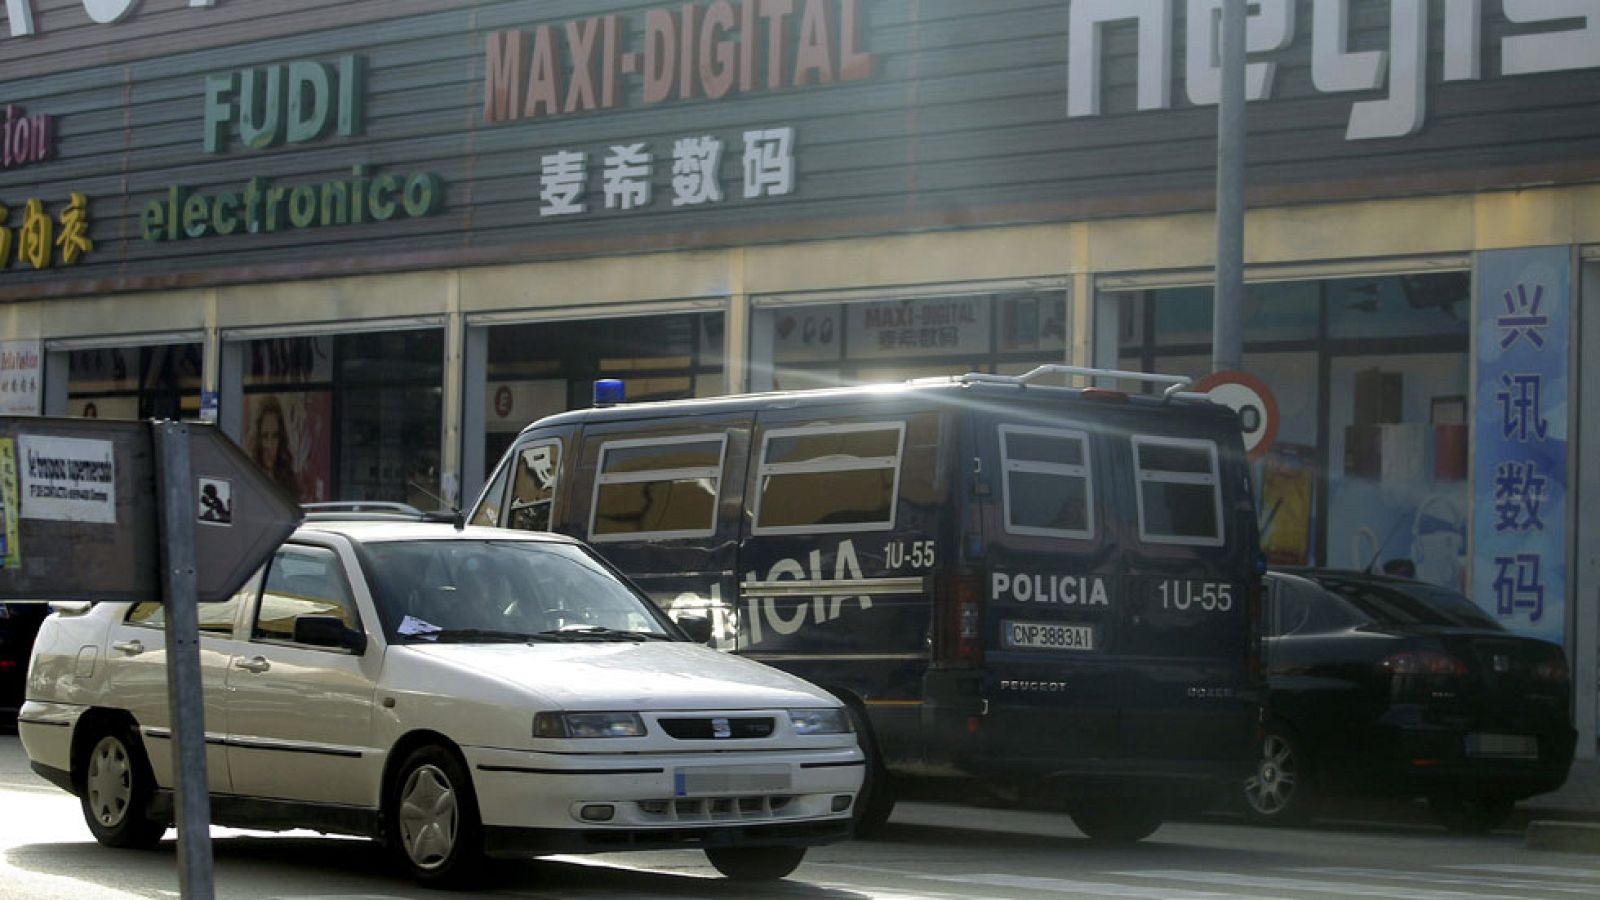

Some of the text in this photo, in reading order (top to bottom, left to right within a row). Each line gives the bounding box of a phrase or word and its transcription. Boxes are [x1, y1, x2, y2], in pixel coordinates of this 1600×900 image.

[483, 0, 878, 123] MAXI-DIGITAL
[0, 104, 53, 168] ion
[203, 54, 366, 154] FUDI
[140, 164, 440, 241] electronico
[538, 127, 796, 217] 麦希数码
[1240, 404, 1260, 434] 0
[1493, 282, 1549, 622] 兴讯数码
[884, 540, 935, 570] 1U-55
[992, 572, 1109, 606] POLICIA
[1158, 580, 1233, 612] 1U-55
